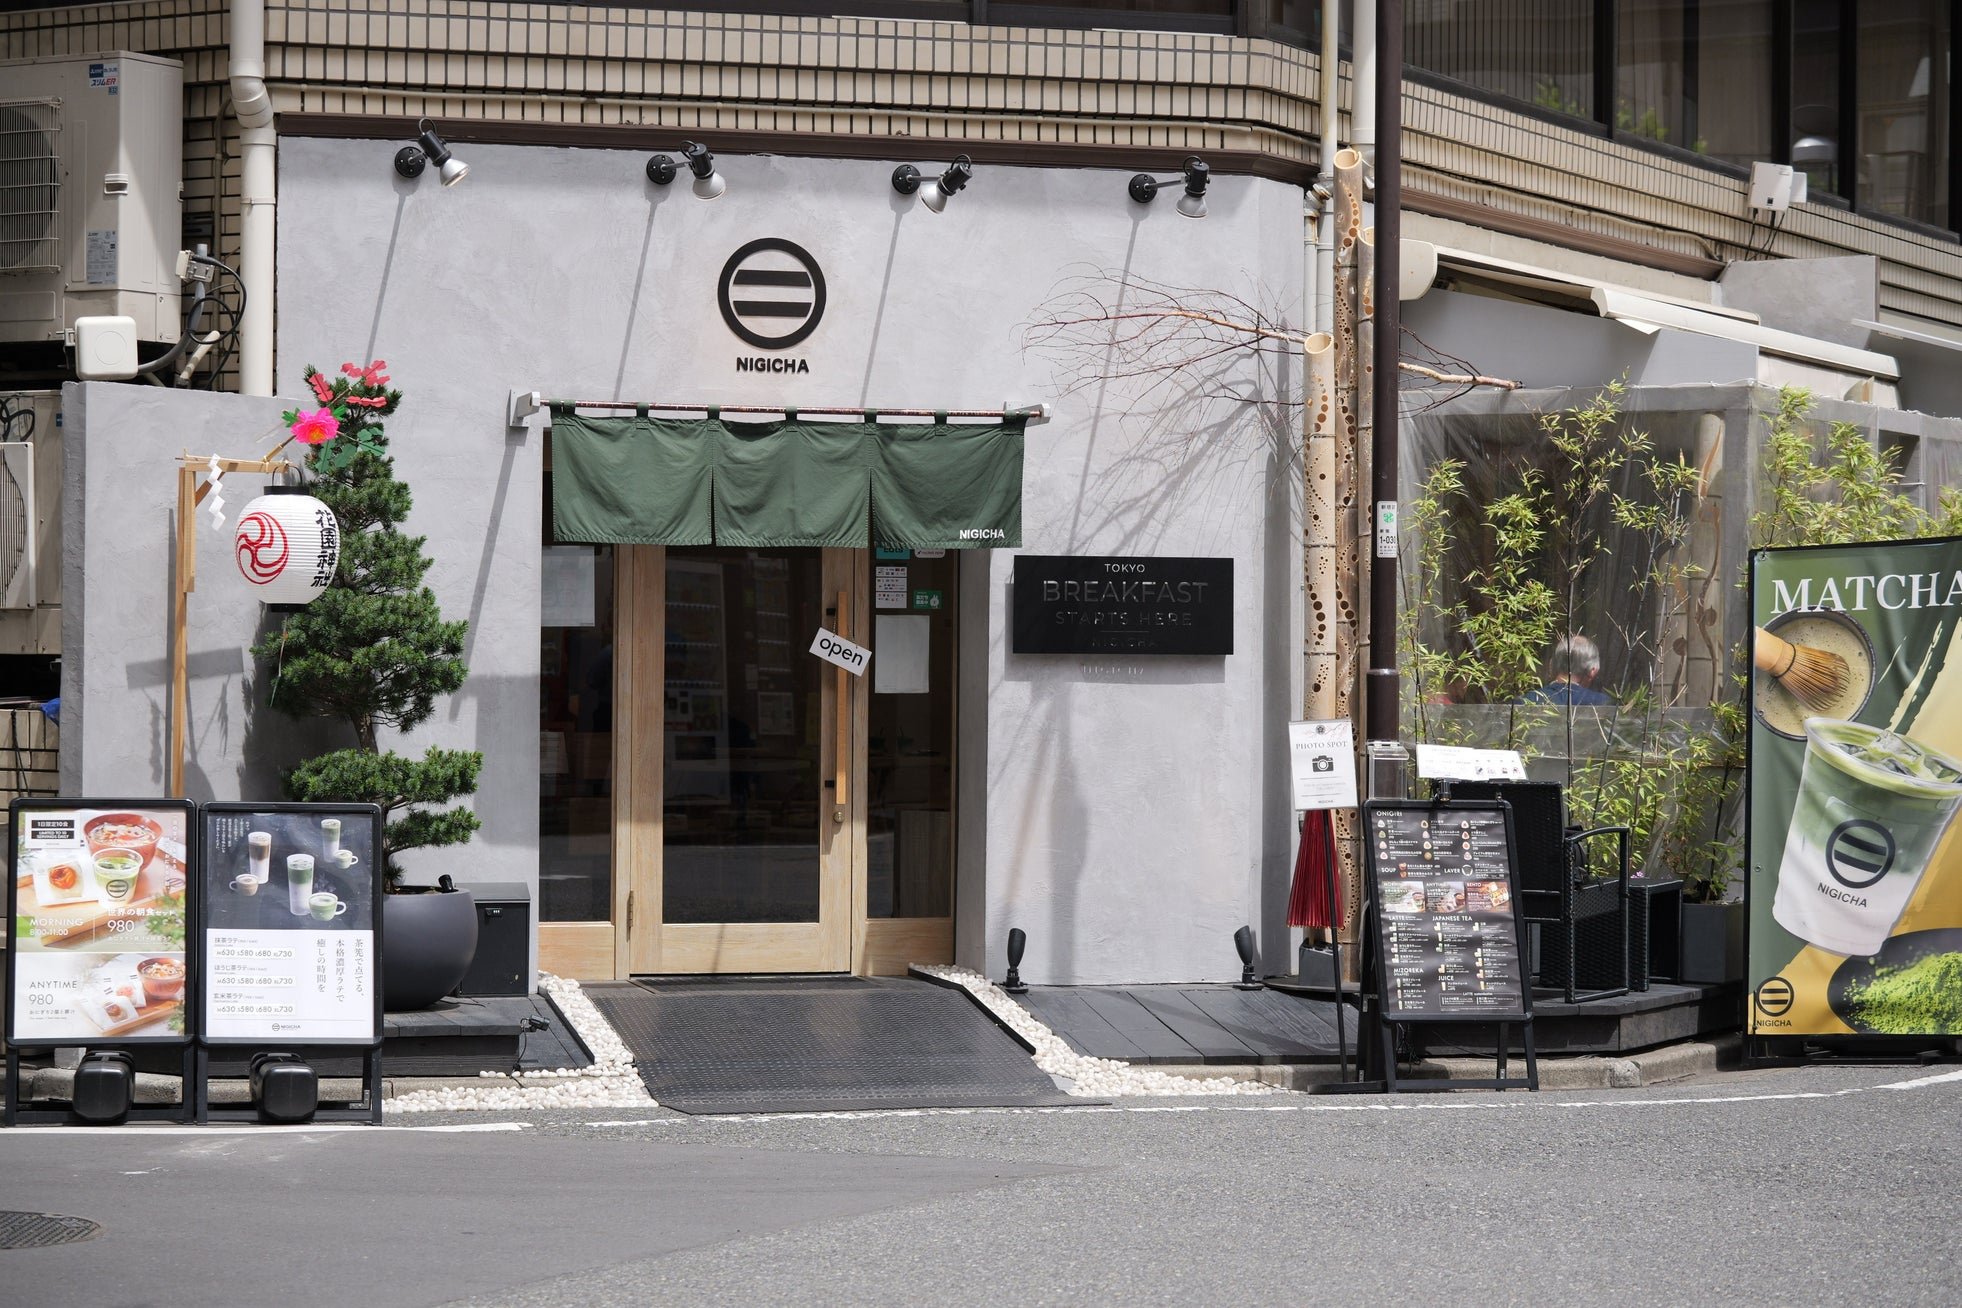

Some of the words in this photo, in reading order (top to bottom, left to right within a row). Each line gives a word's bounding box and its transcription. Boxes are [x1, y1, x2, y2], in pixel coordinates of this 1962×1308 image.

[736, 357, 810, 373] NIGICHA
[959, 528, 1005, 540] NIGICHA
[311, 509, 336, 587] 花園神社
[1104, 563, 1146, 573] TOKYO
[1043, 580, 1208, 603] BREAKFAST
[1770, 570, 1962, 614] MATCHA
[1056, 612, 1128, 626] STARTS
[1140, 612, 1192, 626] HERE
[820, 638, 863, 666] open
[1817, 882, 1868, 908] NIGICHA
[30, 918, 84, 926] MORNING
[108, 920, 134, 932] 980
[30, 980, 77, 988] ANYTIME
[29, 994, 54, 1005] 980
[1756, 1019, 1792, 1027] NIGICHA
